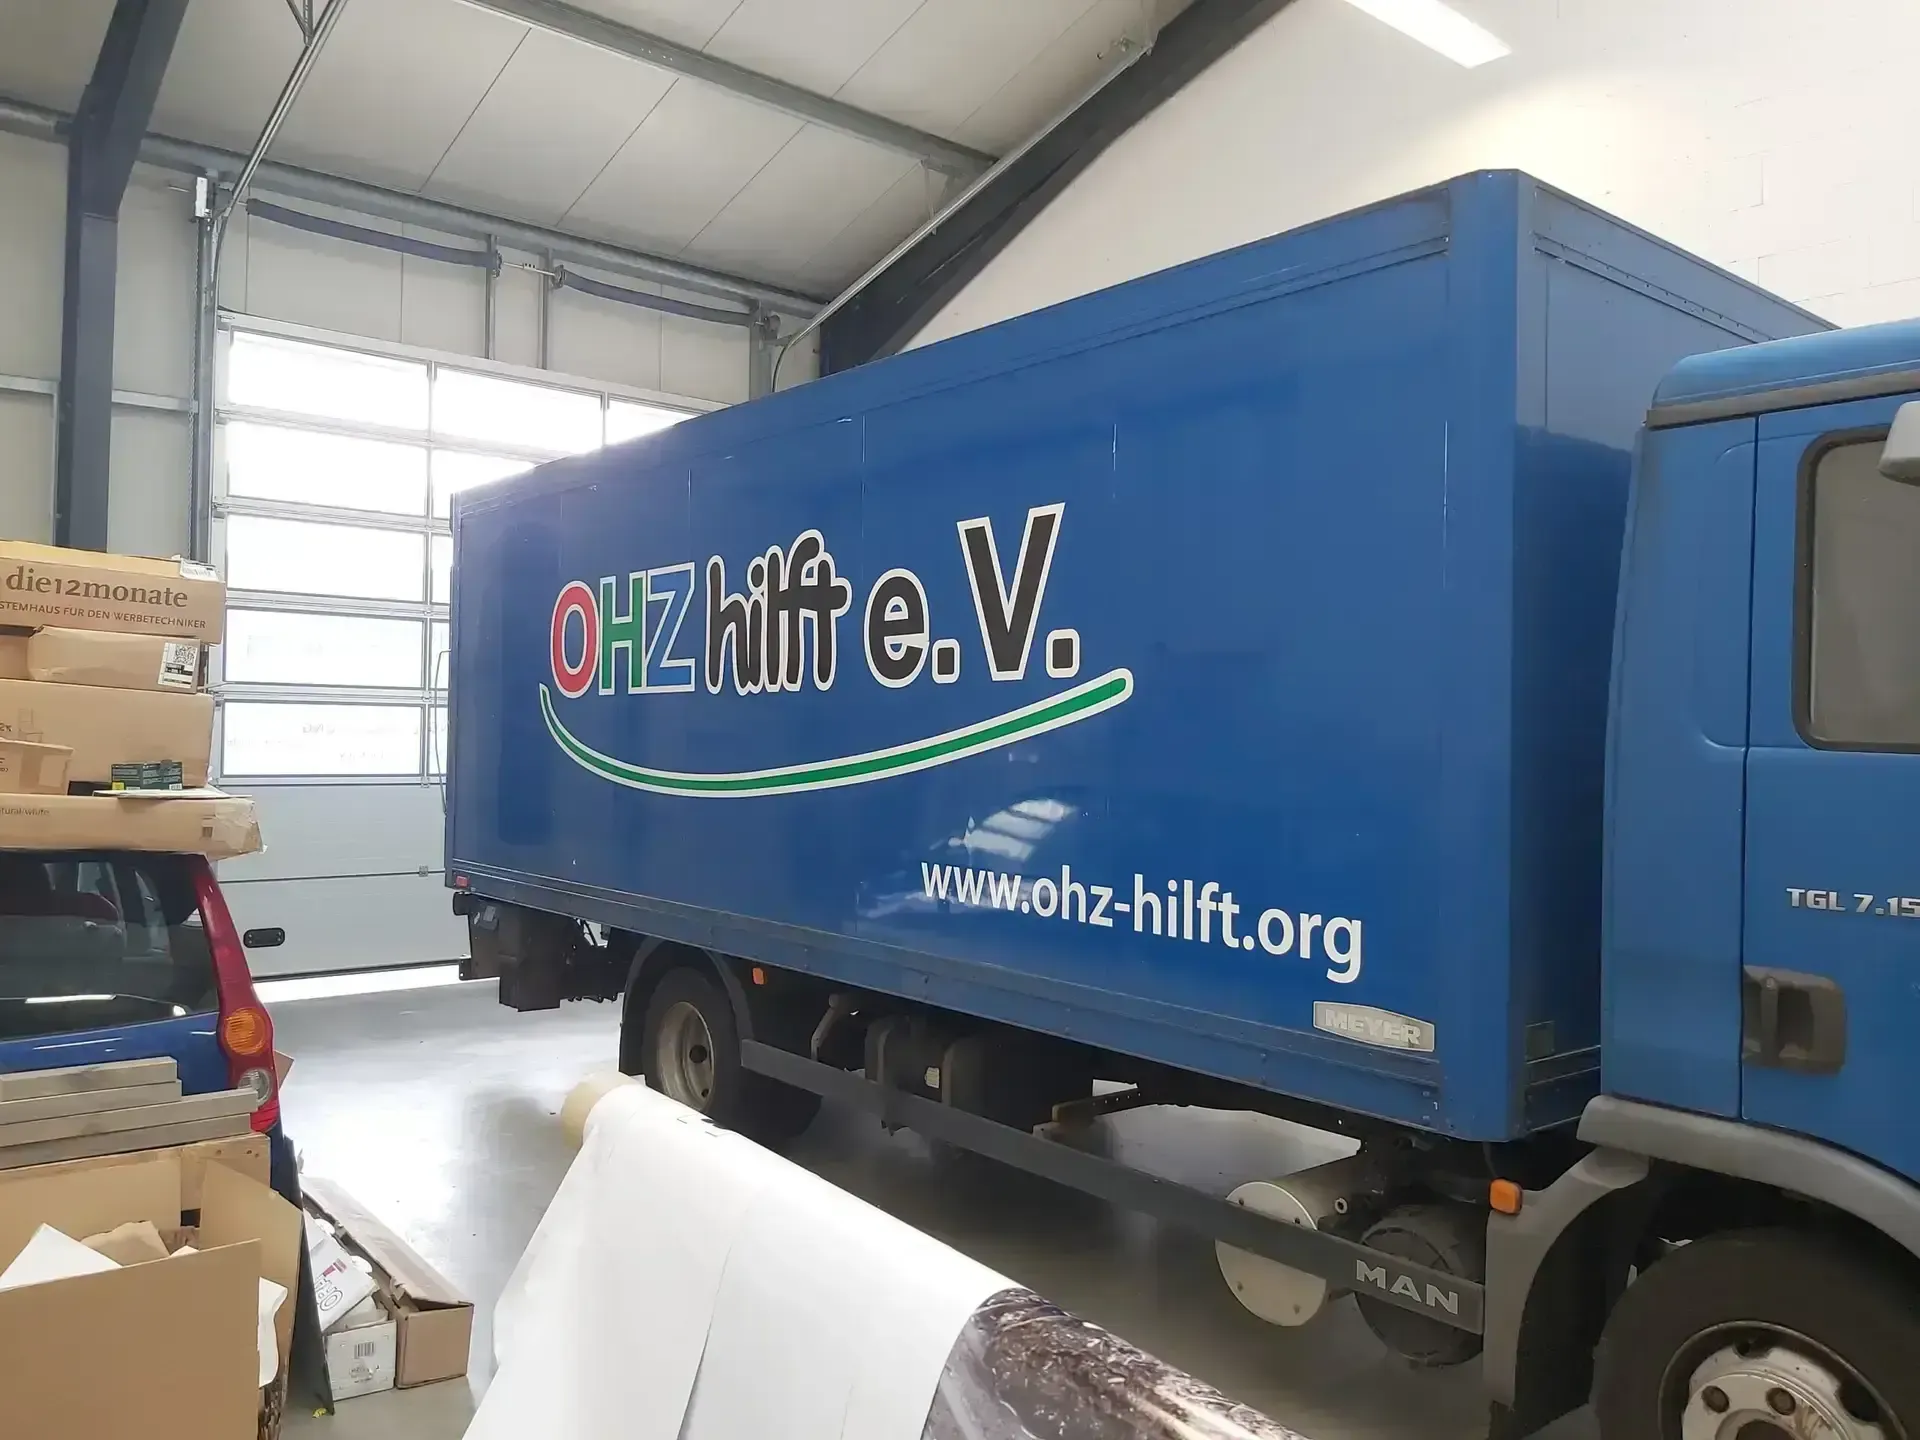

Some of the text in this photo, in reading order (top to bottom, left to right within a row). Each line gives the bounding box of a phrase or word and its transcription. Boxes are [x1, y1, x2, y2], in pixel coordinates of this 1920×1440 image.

[6, 565, 188, 608] die12monate
[87, 609, 110, 619] DEN
[113, 611, 206, 628] WERBETECHNIKER
[550, 562, 696, 698] OHZ
[705, 529, 852, 695] hilft
[1786, 887, 1846, 912] TGL
[921, 862, 1362, 983] www.ohz-hilft.org
[1325, 1009, 1421, 1045] MEYER
[1356, 1259, 1458, 1315] MAN
